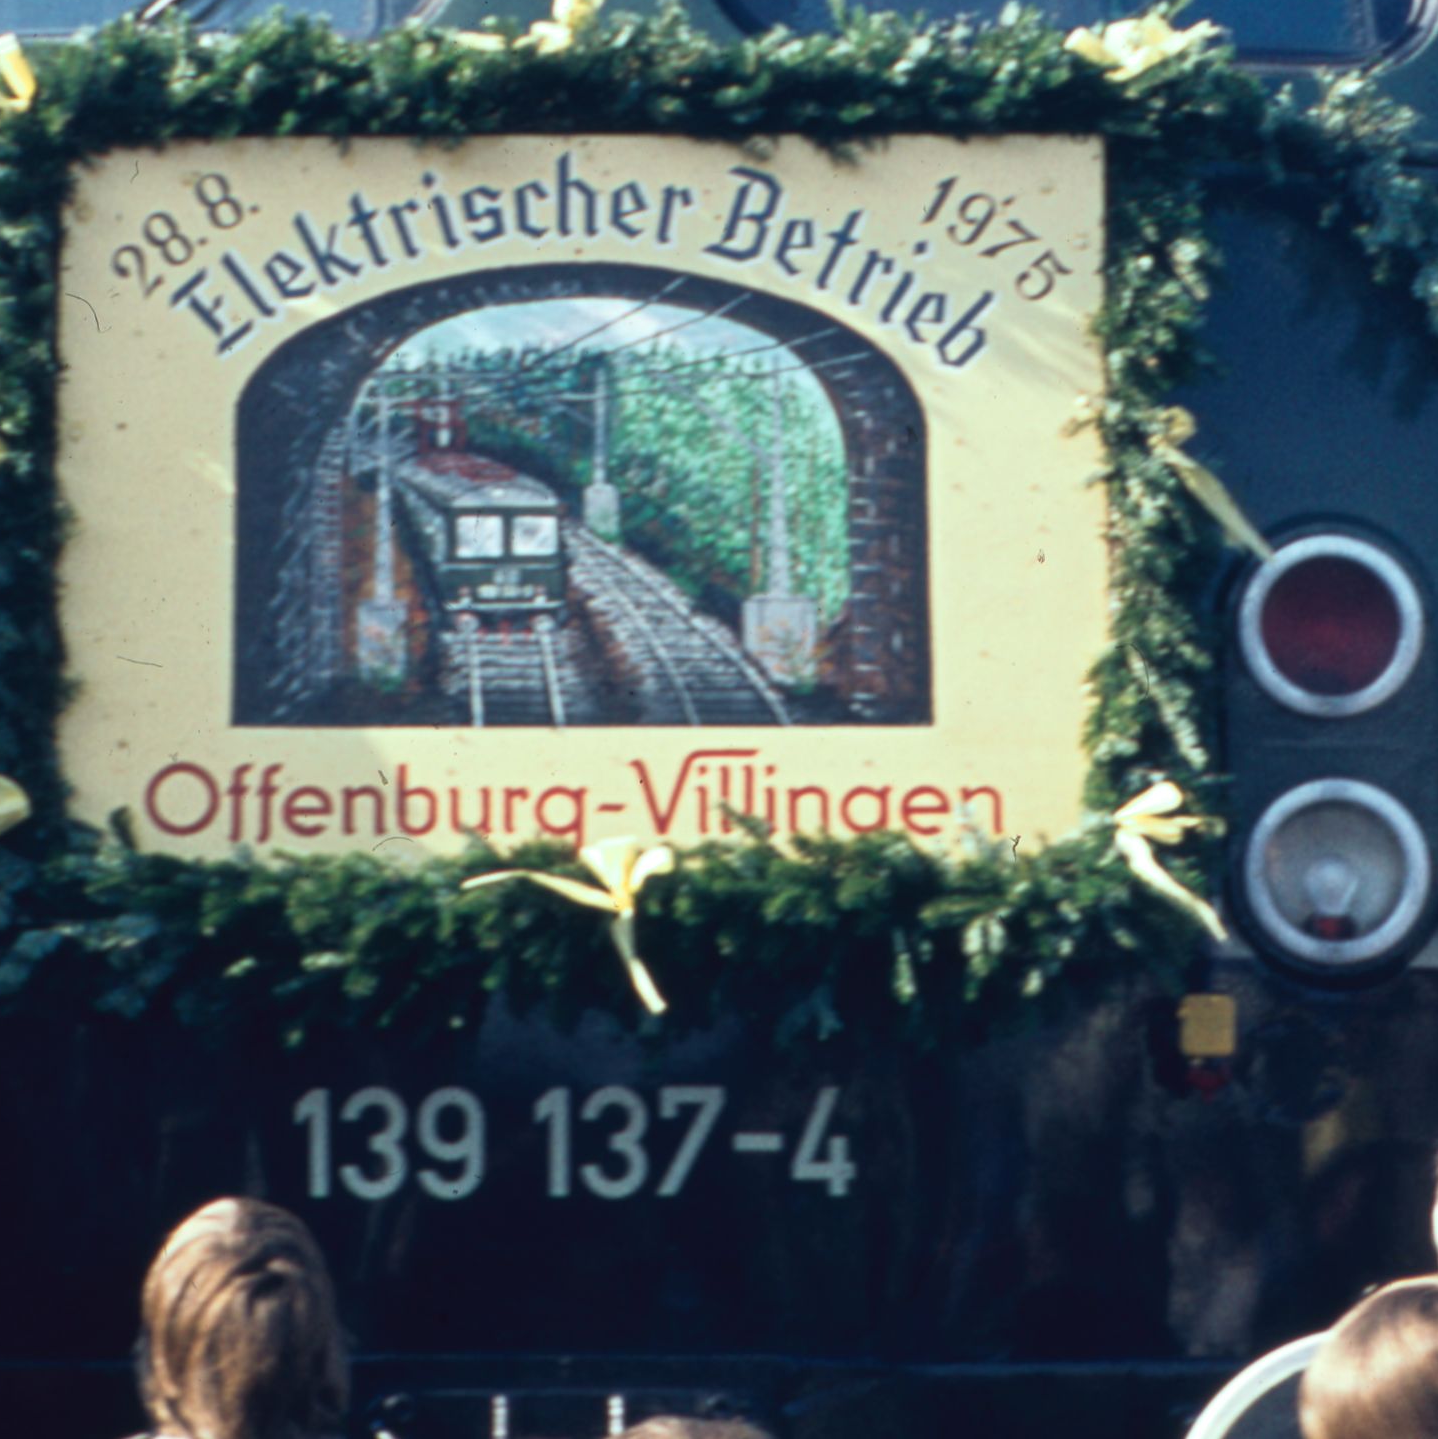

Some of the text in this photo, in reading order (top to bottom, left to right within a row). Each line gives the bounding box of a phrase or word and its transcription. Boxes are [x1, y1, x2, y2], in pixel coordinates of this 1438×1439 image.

[109, 172, 261, 300] 28.8.
[170, 152, 993, 370] Elektrischer Betrieb
[919, 174, 1074, 304] 1975
[143, 747, 1007, 848] Offenburg-Villingen
[293, 1086, 857, 1200] 139 137-4
